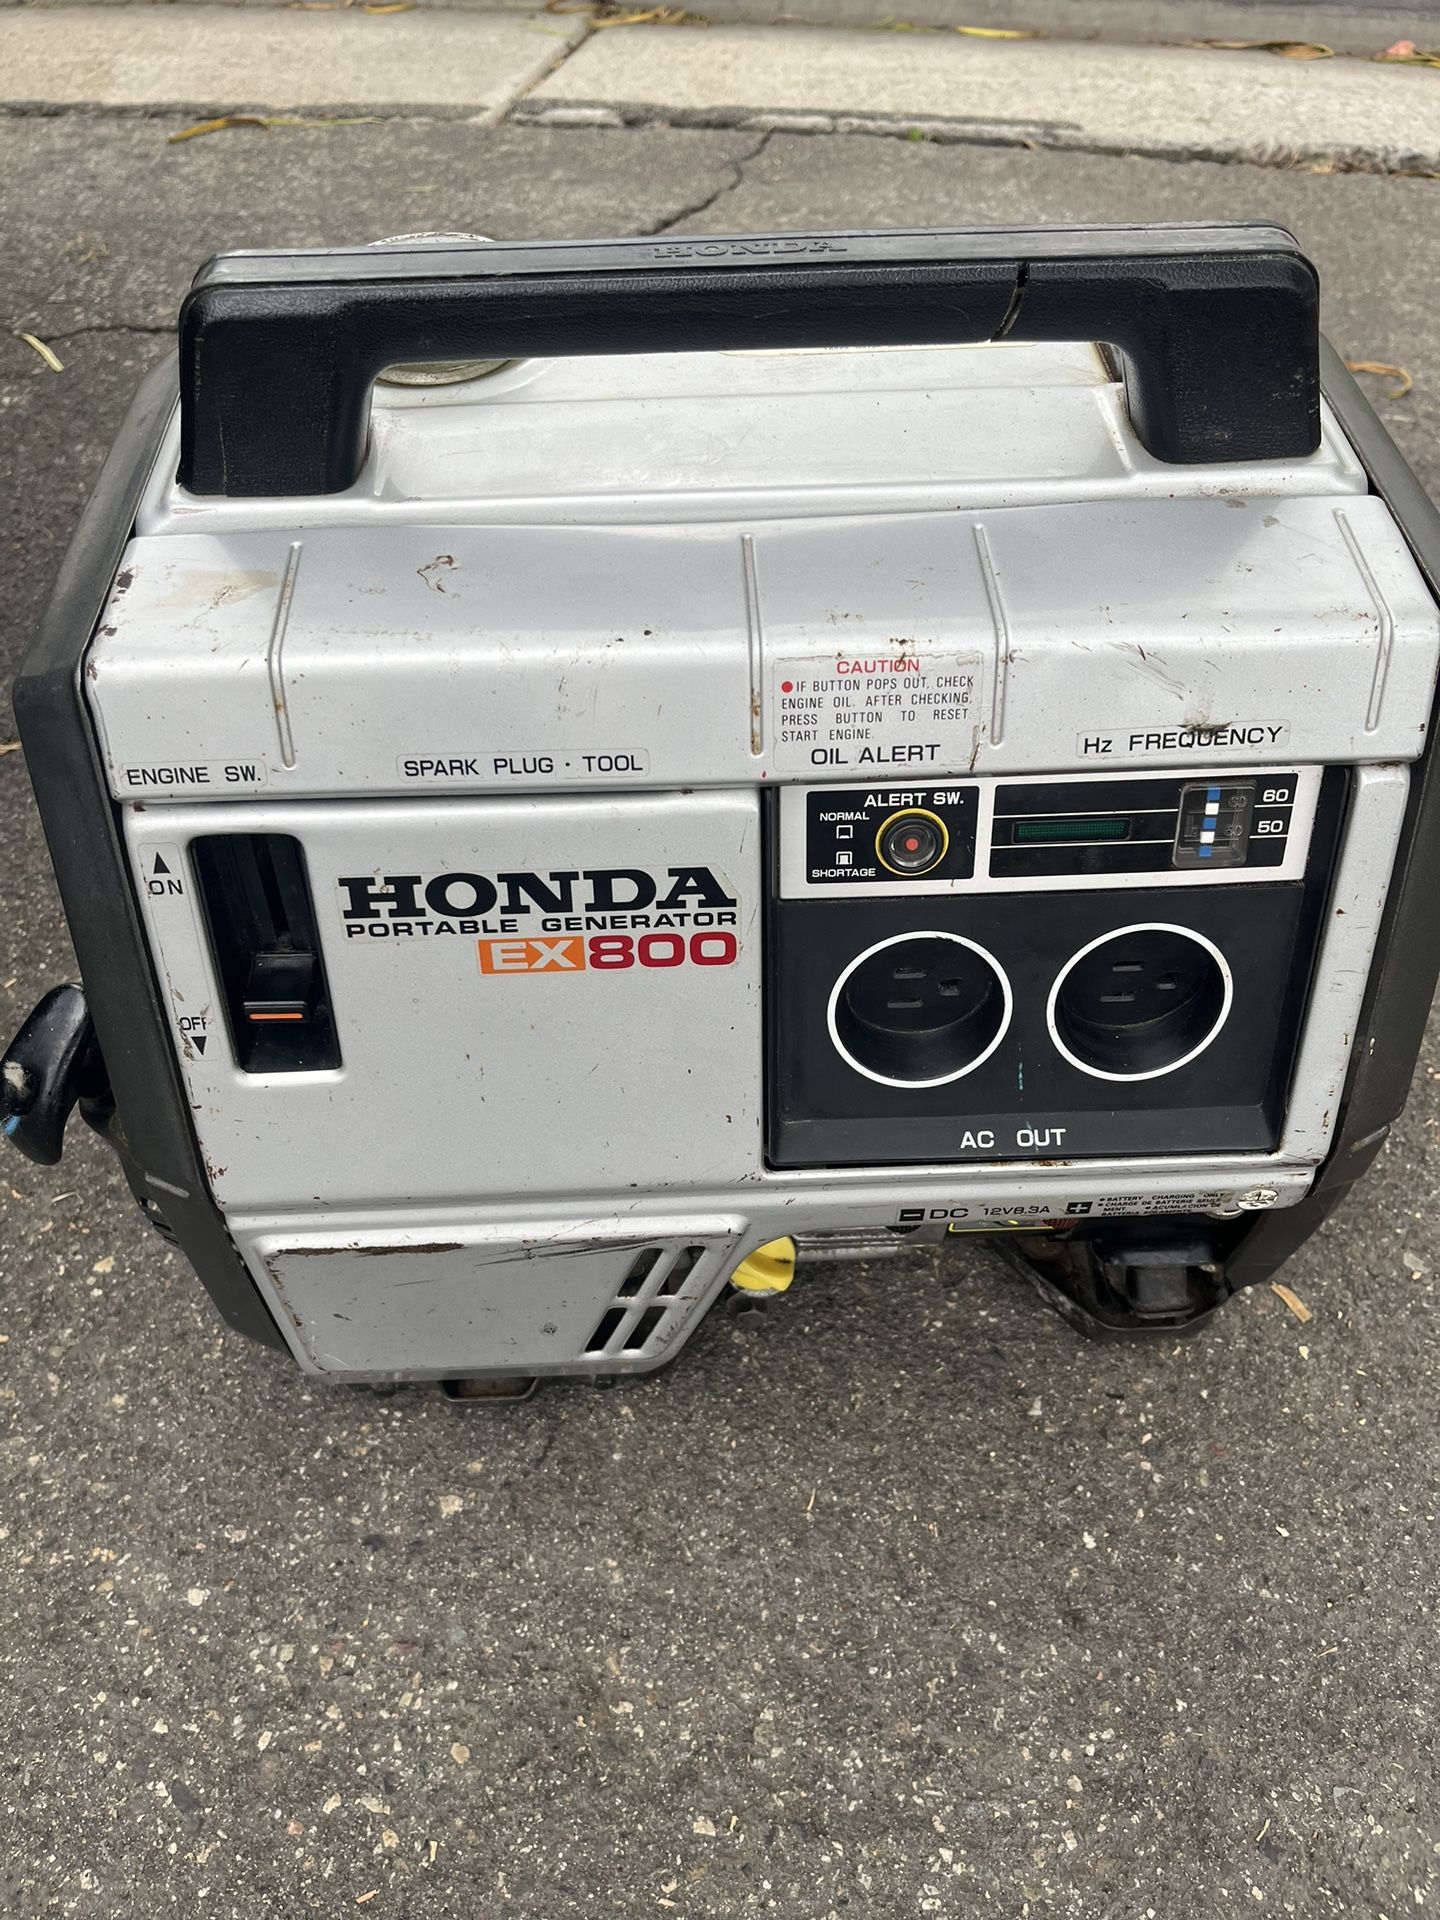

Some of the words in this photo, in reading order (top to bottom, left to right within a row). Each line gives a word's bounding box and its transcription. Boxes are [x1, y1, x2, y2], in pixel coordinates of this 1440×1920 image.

[655, 242, 847, 258] HONDA
[837, 659, 920, 674] CAUTION
[796, 681, 806, 693] IF
[813, 680, 860, 692] BUTTON
[866, 678, 897, 690] POPS
[937, 675, 974, 688] CHECK
[781, 697, 824, 710] ENGINE
[865, 694, 902, 707] AFTER
[781, 714, 818, 726] PRESS
[835, 712, 883, 724] BUTTON
[901, 710, 916, 722] TO
[781, 730, 819, 743] START
[1083, 737, 1112, 754] Hz
[1128, 726, 1284, 751] FREQUENCY
[811, 748, 849, 766] OIL
[858, 744, 941, 764] ALERT
[404, 758, 480, 778] SPARK
[493, 757, 554, 775] PLUG
[582, 755, 643, 773] TOOL
[127, 766, 210, 786] ENGINE
[224, 765, 262, 783] SW.
[864, 793, 927, 808] ALERT
[933, 791, 965, 805] SW.
[1262, 789, 1290, 802] 60
[820, 811, 871, 821] NORMAL
[1257, 820, 1284, 833] 50
[812, 868, 876, 878] SHORTAGE
[149, 880, 183, 896] ON
[338, 867, 738, 920] HONDA
[346, 918, 520, 938] PORTABLE
[541, 912, 738, 932] GENERATOR
[960, 1130, 995, 1149] AC
[1016, 1129, 1066, 1147] OUT
[930, 1208, 969, 1220] DC
